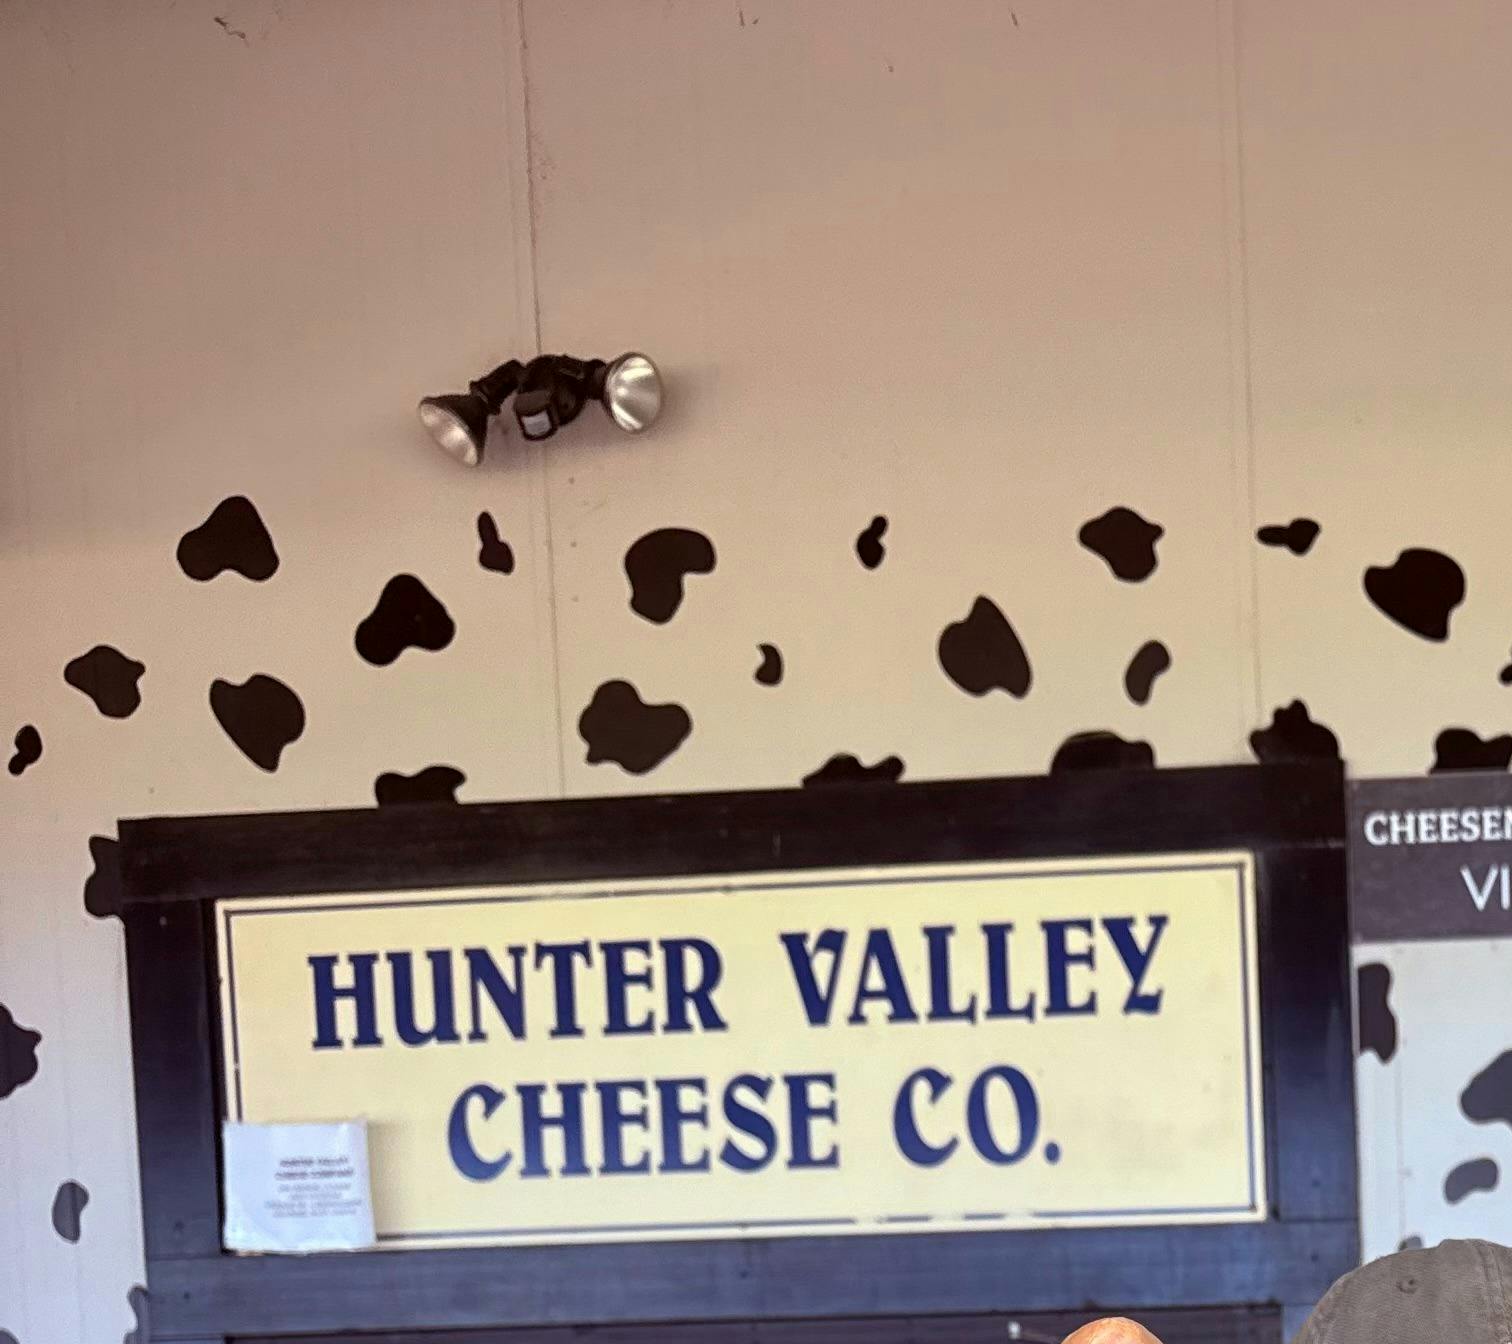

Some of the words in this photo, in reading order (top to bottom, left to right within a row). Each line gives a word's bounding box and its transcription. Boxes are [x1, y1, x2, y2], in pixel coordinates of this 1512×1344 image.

[308, 937, 727, 1050] HUNTER
[779, 914, 1168, 1027] VALLEY
[446, 1072, 838, 1182] CHEESE
[892, 1065, 1060, 1168] CO.
